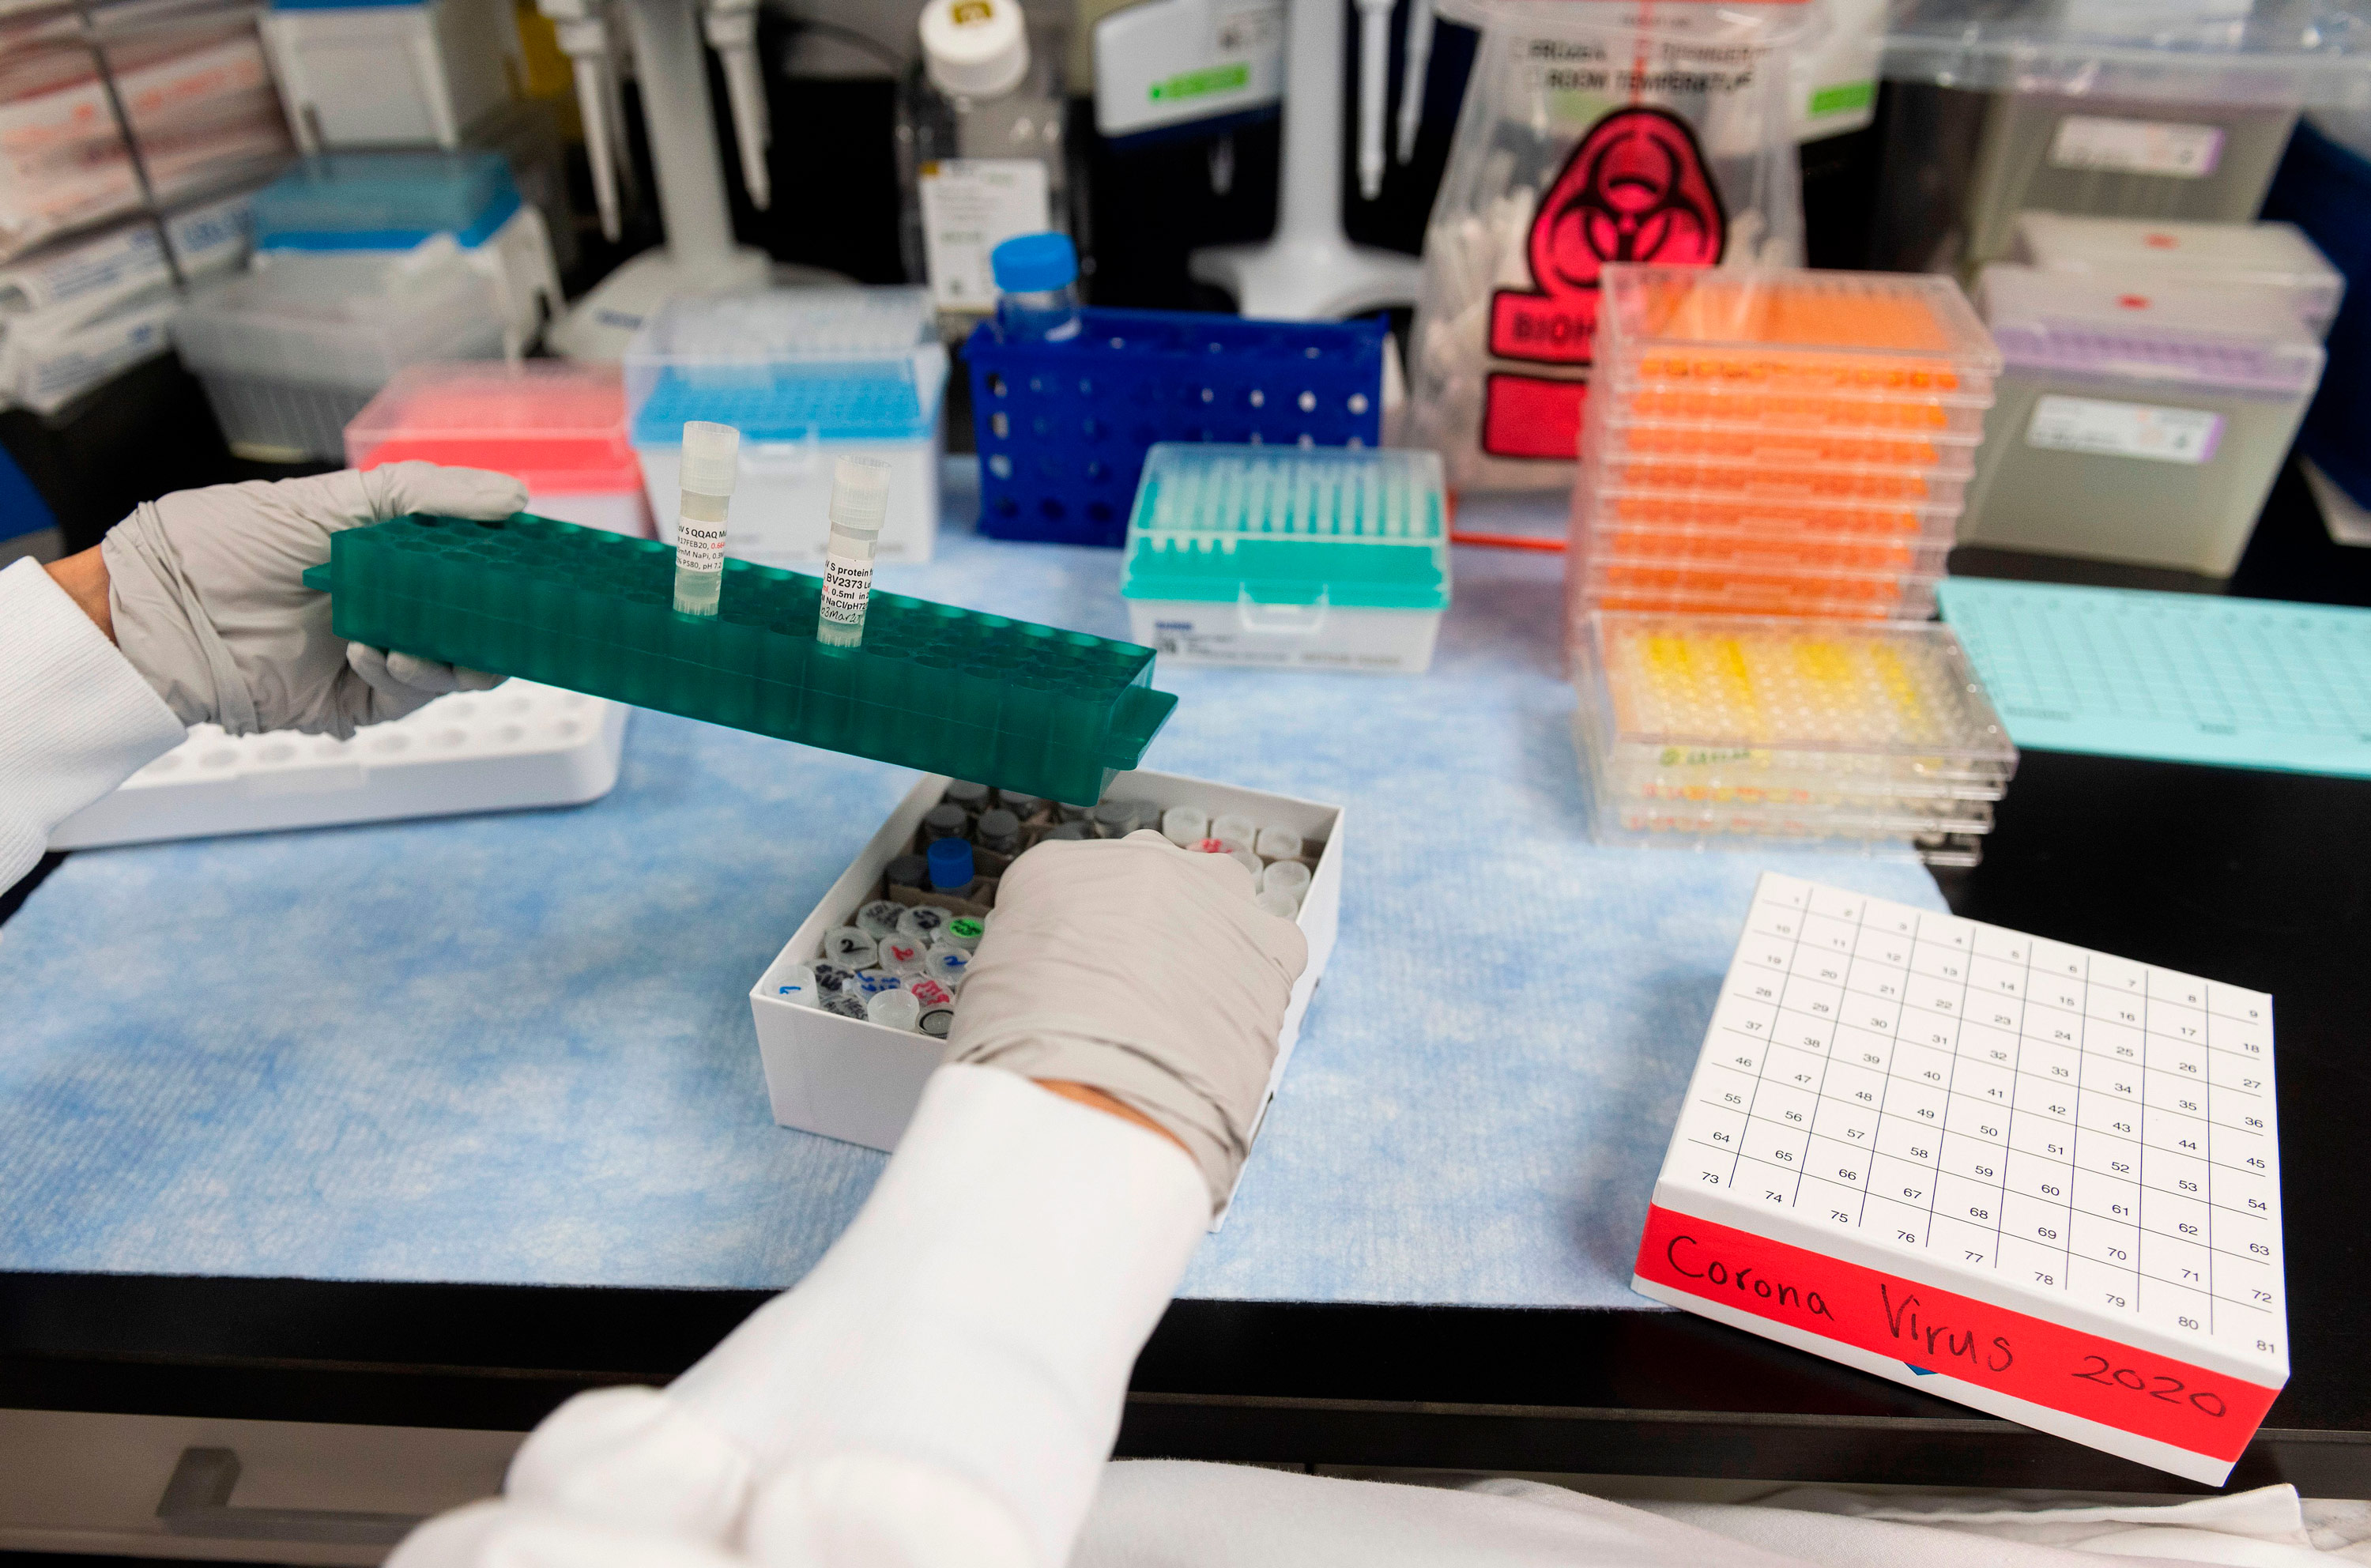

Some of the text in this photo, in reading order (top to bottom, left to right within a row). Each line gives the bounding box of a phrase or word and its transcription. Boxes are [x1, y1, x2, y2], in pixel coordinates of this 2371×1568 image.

[1513, 313, 1597, 344] BIOH
[692, 529, 718, 538] QQAQ
[827, 573, 863, 589] BV2373
[831, 563, 836, 571] S
[838, 567, 869, 577] protein
[831, 588, 854, 599] 0.5ml
[1756, 988, 1771, 997] 28
[1872, 1019, 1887, 1028] 30
[1932, 1035, 1947, 1044] 31
[1990, 1050, 2007, 1061] 32
[2052, 1067, 2068, 1077] 33
[2115, 1083, 2132, 1094] 34
[2179, 1100, 2197, 1110] 35
[2245, 1117, 2264, 1128] 36
[1768, 956, 2261, 1088] 19 20 21 22 23 24 25 26 27
[1887, 952, 1901, 961] 12
[1943, 967, 1958, 976] 13
[2001, 982, 2015, 991] 14
[2060, 996, 2075, 1006] 15
[2120, 1012, 2135, 1022] 16
[2181, 1027, 2196, 1036] 17
[2244, 1043, 2260, 1054] 18
[1736, 1057, 2267, 1211] 46 47 48 49 50 51 52 53 54
[1746, 1021, 2265, 1169] 37 38 39 40 41 42 43 44 45
[1713, 1132, 2271, 1303] 64 65 66 67 68 69 70 71 72
[1725, 1093, 2270, 1256] 55 56 57 58 59 60 61 62 63
[1668, 1235, 2226, 1417] Corona Virus 2020
[1702, 1171, 2275, 1353] 73 74 75 76 77 78 79 80 81
